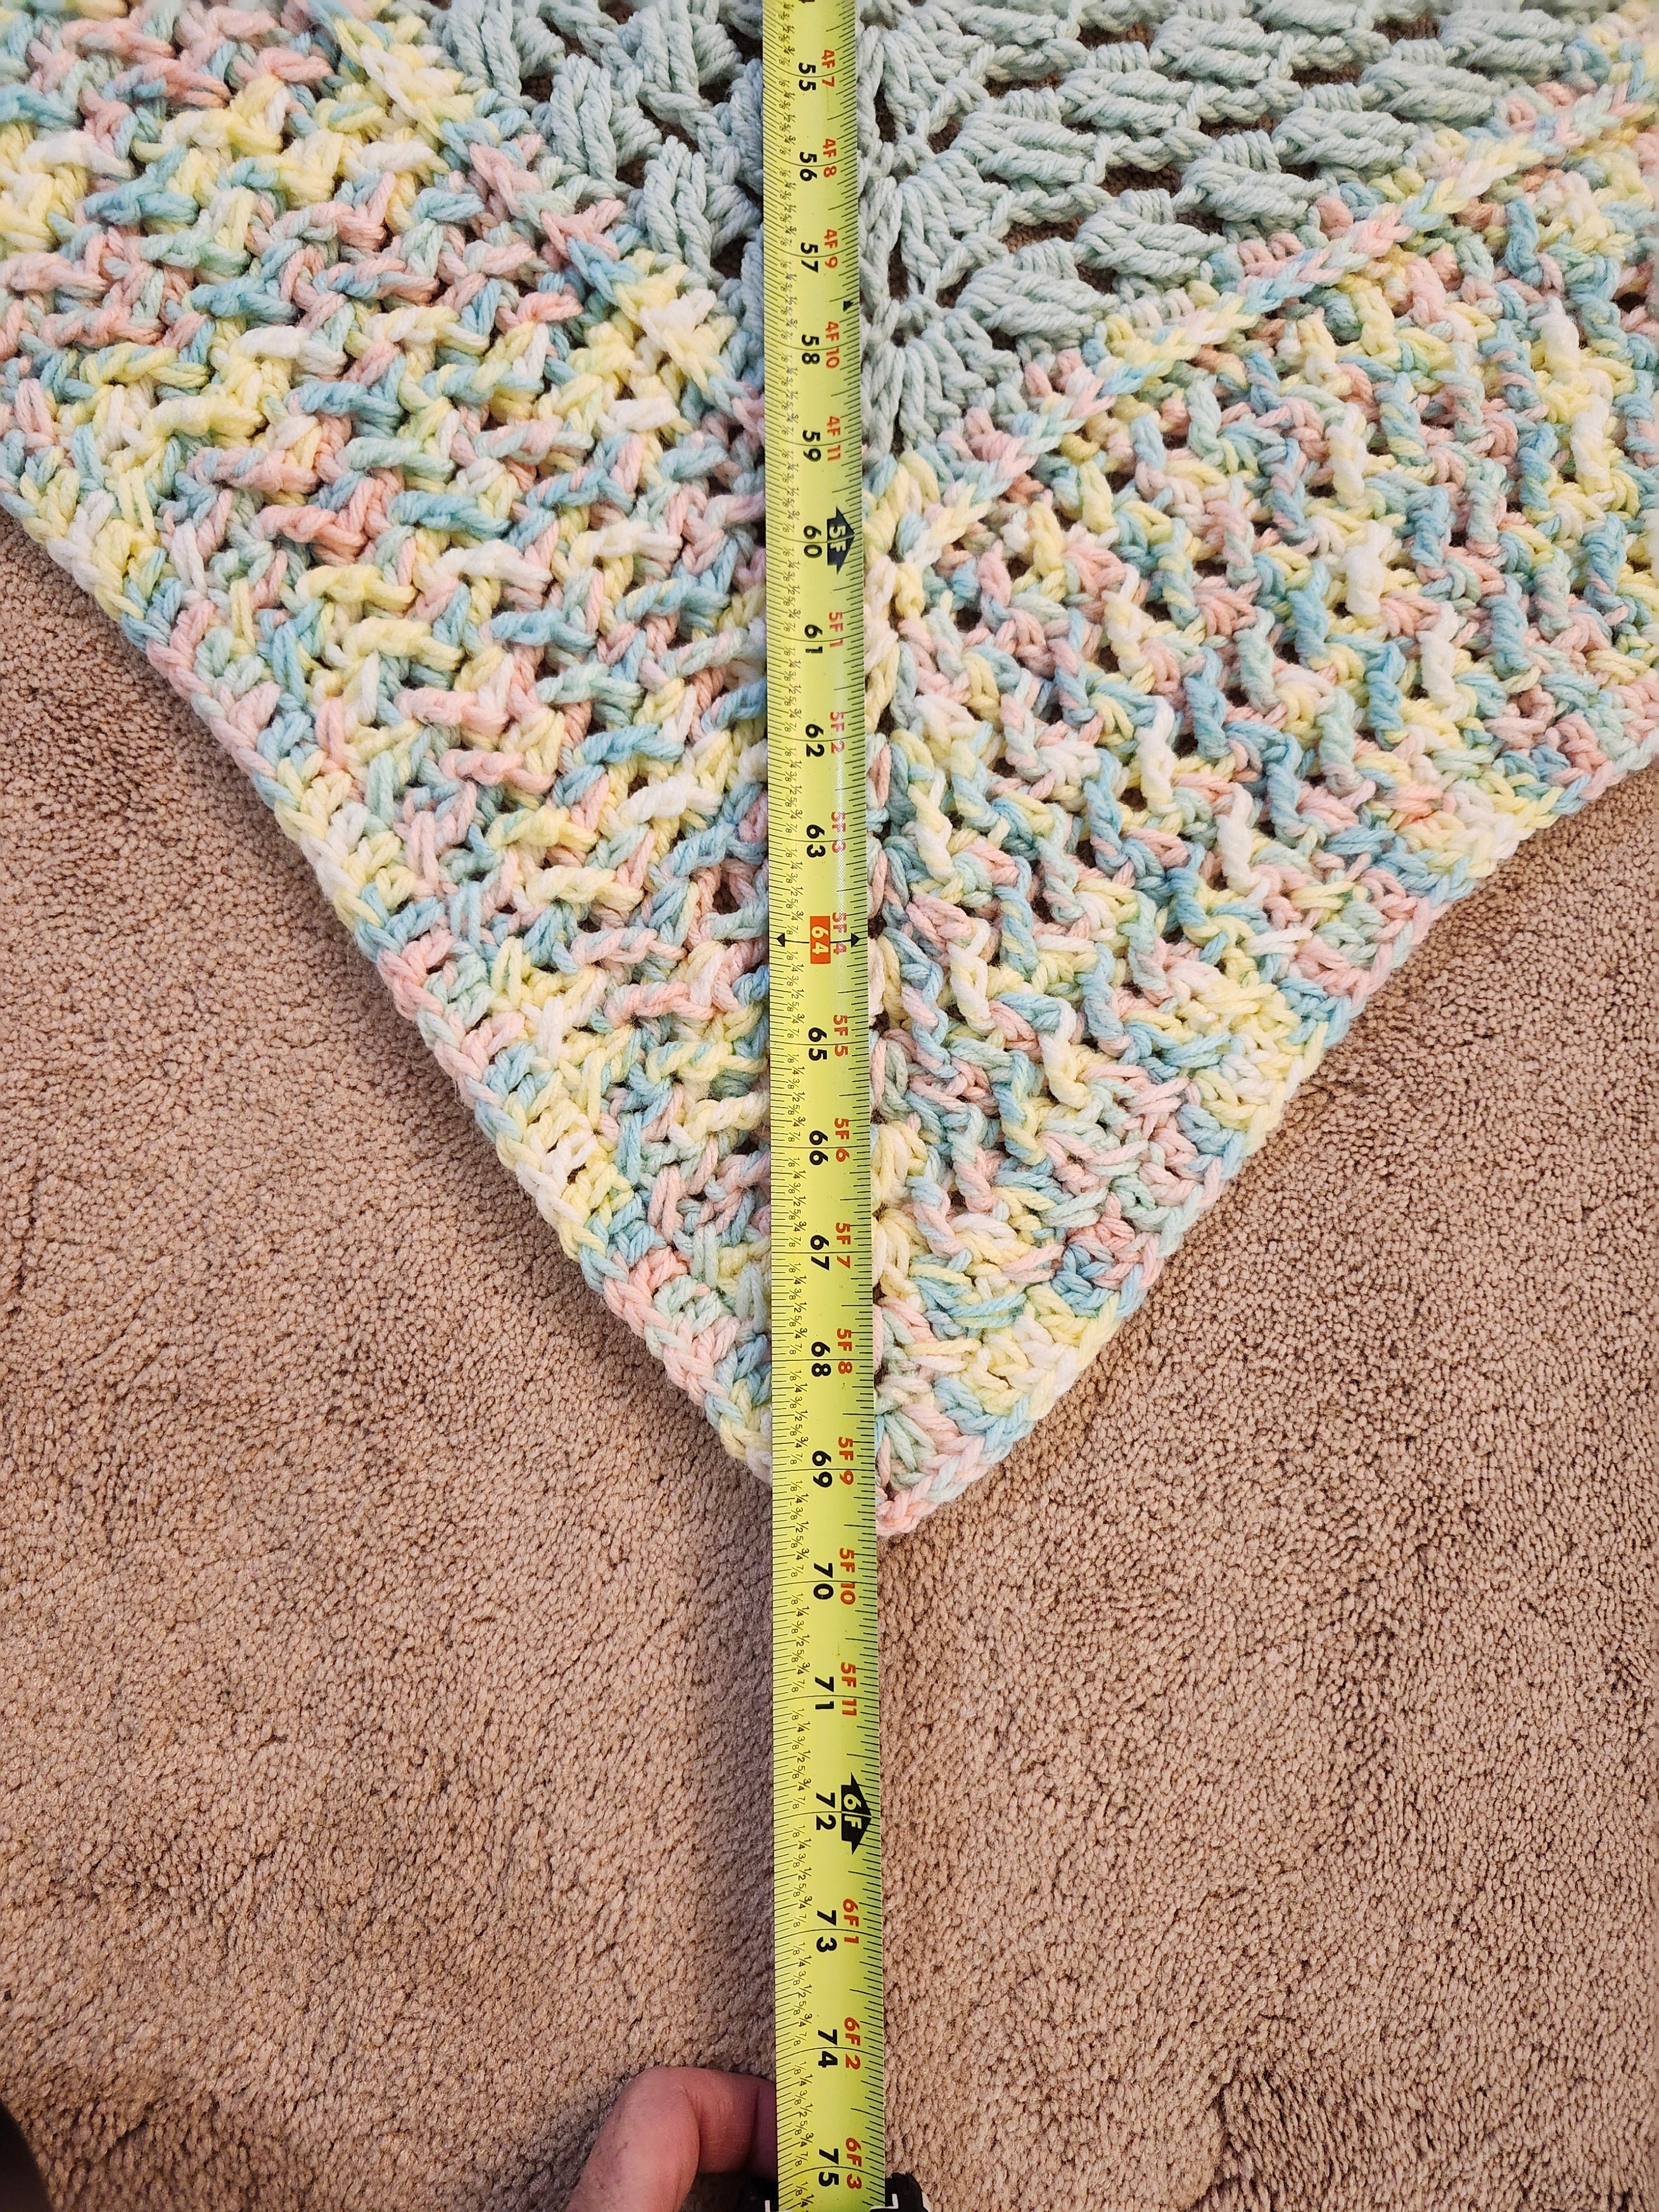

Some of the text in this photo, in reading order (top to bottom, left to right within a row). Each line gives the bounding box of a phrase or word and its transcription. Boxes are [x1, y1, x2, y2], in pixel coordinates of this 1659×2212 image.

[799, 62, 816, 91] 55
[822, 50, 835, 87] 4F 7
[800, 152, 817, 181] 56
[823, 139, 837, 178] 4F 8
[801, 242, 818, 273] 57
[824, 229, 838, 268] 4F 9
[802, 335, 820, 364] 58
[825, 321, 839, 368] 4F 10
[802, 430, 821, 461] 59
[827, 416, 841, 461] 4F 11
[804, 526, 822, 558] 60
[830, 526, 847, 552] 5F
[805, 624, 823, 654] 61
[829, 612, 843, 648] 5F 1
[806, 724, 825, 757] 62
[830, 712, 845, 754] 5F 2
[806, 825, 826, 858] 63
[831, 812, 846, 853] 5F 3
[811, 926, 828, 954] 64
[832, 912, 847, 954] 5F 4
[808, 1027, 827, 1061] 65
[833, 1015, 848, 1057] 5F 5
[809, 1130, 828, 1165] 66
[834, 1118, 849, 1162] 5F 6
[810, 1235, 829, 1271] 67
[836, 1223, 851, 1269] 5F 7
[811, 1342, 831, 1376] 68
[837, 1328, 852, 1374] 5F 8
[812, 1451, 833, 1488] 69
[838, 1437, 854, 1485] 5F 9
[813, 1563, 834, 1599] 70
[839, 1548, 855, 1605] 5F 10
[815, 1677, 834, 1709] 71
[841, 1662, 857, 1716] 5F 11
[816, 1793, 836, 1830] 72
[844, 1793, 862, 1829] 6F
[843, 1898, 859, 1927] 6F
[816, 1910, 837, 1953] 73
[818, 2029, 838, 2068] 74
[844, 2017, 861, 2069] 6F 2
[818, 2148, 839, 2187] 75
[846, 2137, 862, 2189] 6F 3
